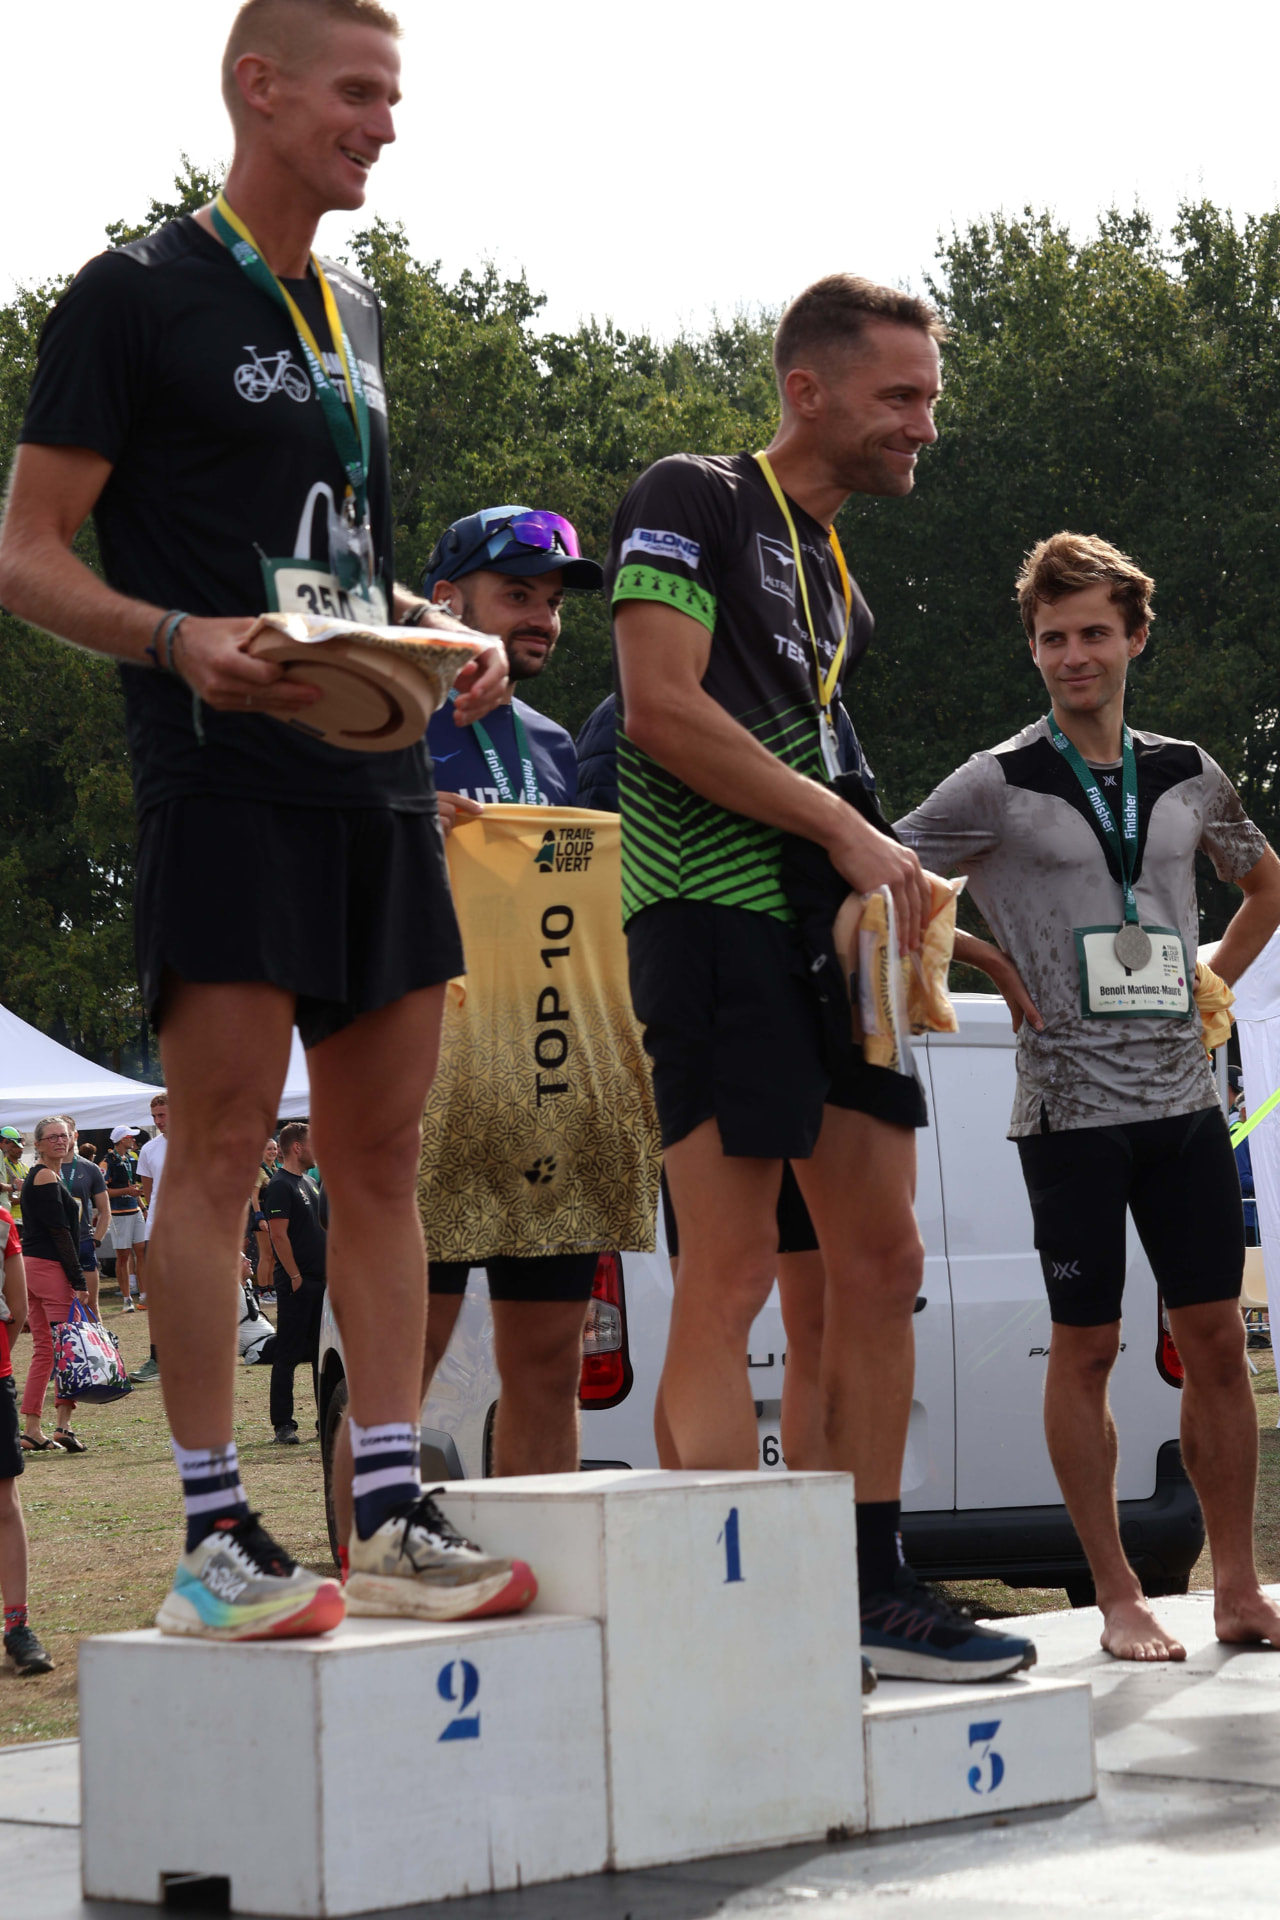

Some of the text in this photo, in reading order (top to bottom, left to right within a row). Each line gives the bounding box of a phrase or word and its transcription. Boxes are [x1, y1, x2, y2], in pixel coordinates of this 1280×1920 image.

[639, 531, 701, 557] BLOND
[484, 749, 514, 801] Finisher
[521, 758, 538, 806] Finisher
[1086, 786, 1116, 834] Finisher
[1124, 792, 1137, 840] Finisher
[555, 857, 592, 873] VERT
[556, 841, 594, 857] LOUP
[535, 905, 575, 1108] TOP 10
[1127, 984, 1182, 997] Martinez-Maure
[716, 1506, 746, 1584] 1
[200, 1555, 249, 1602] HOKA
[437, 1658, 481, 1743] 2
[968, 1720, 1005, 1795] 3
